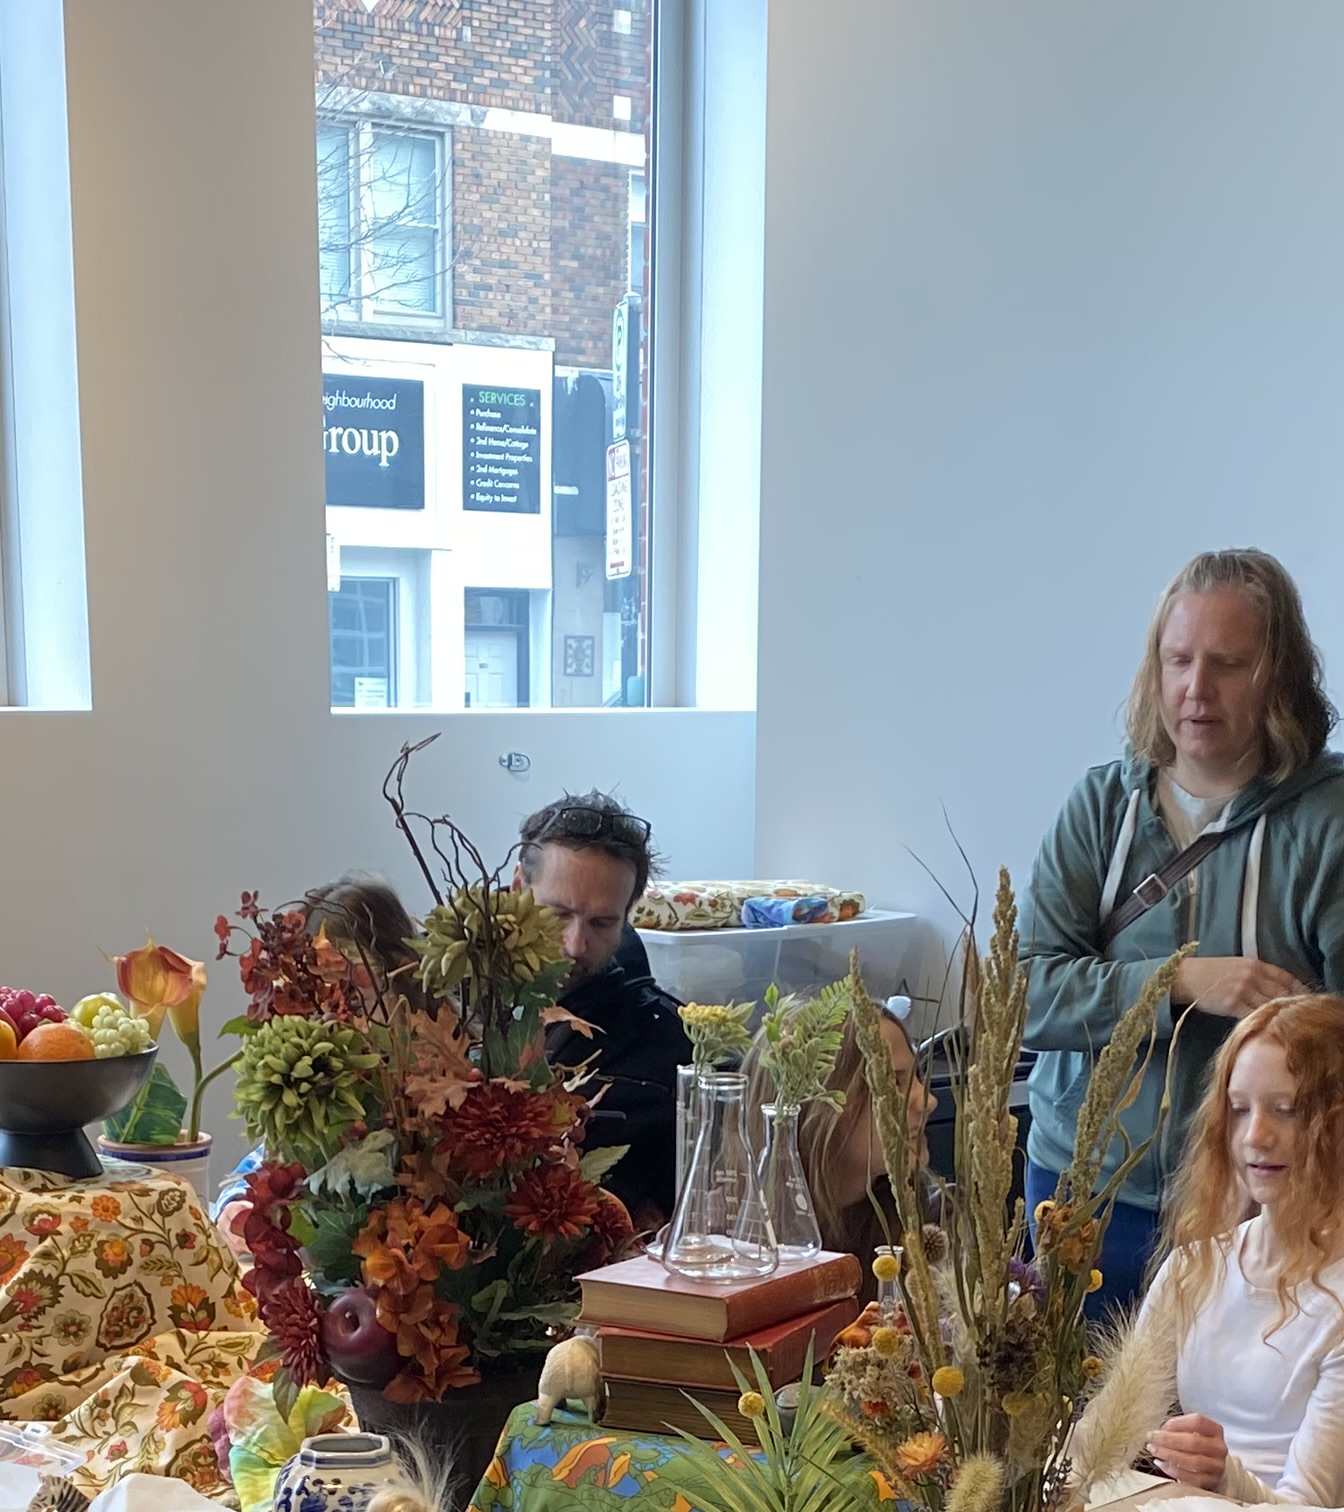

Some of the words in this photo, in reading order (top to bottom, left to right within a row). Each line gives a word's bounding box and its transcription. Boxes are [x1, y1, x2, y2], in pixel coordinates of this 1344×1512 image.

[479, 391, 526, 406] SERVICES
[476, 409, 501, 418] Purchase
[476, 437, 487, 445] 2nd
[476, 452, 504, 460] Investment
[476, 465, 487, 473] 2nd
[489, 466, 518, 476] Mortgages
[476, 478, 493, 487] Credit
[476, 493, 493, 502] Equity
[494, 494, 500, 502] to
[501, 494, 517, 502] Invest
